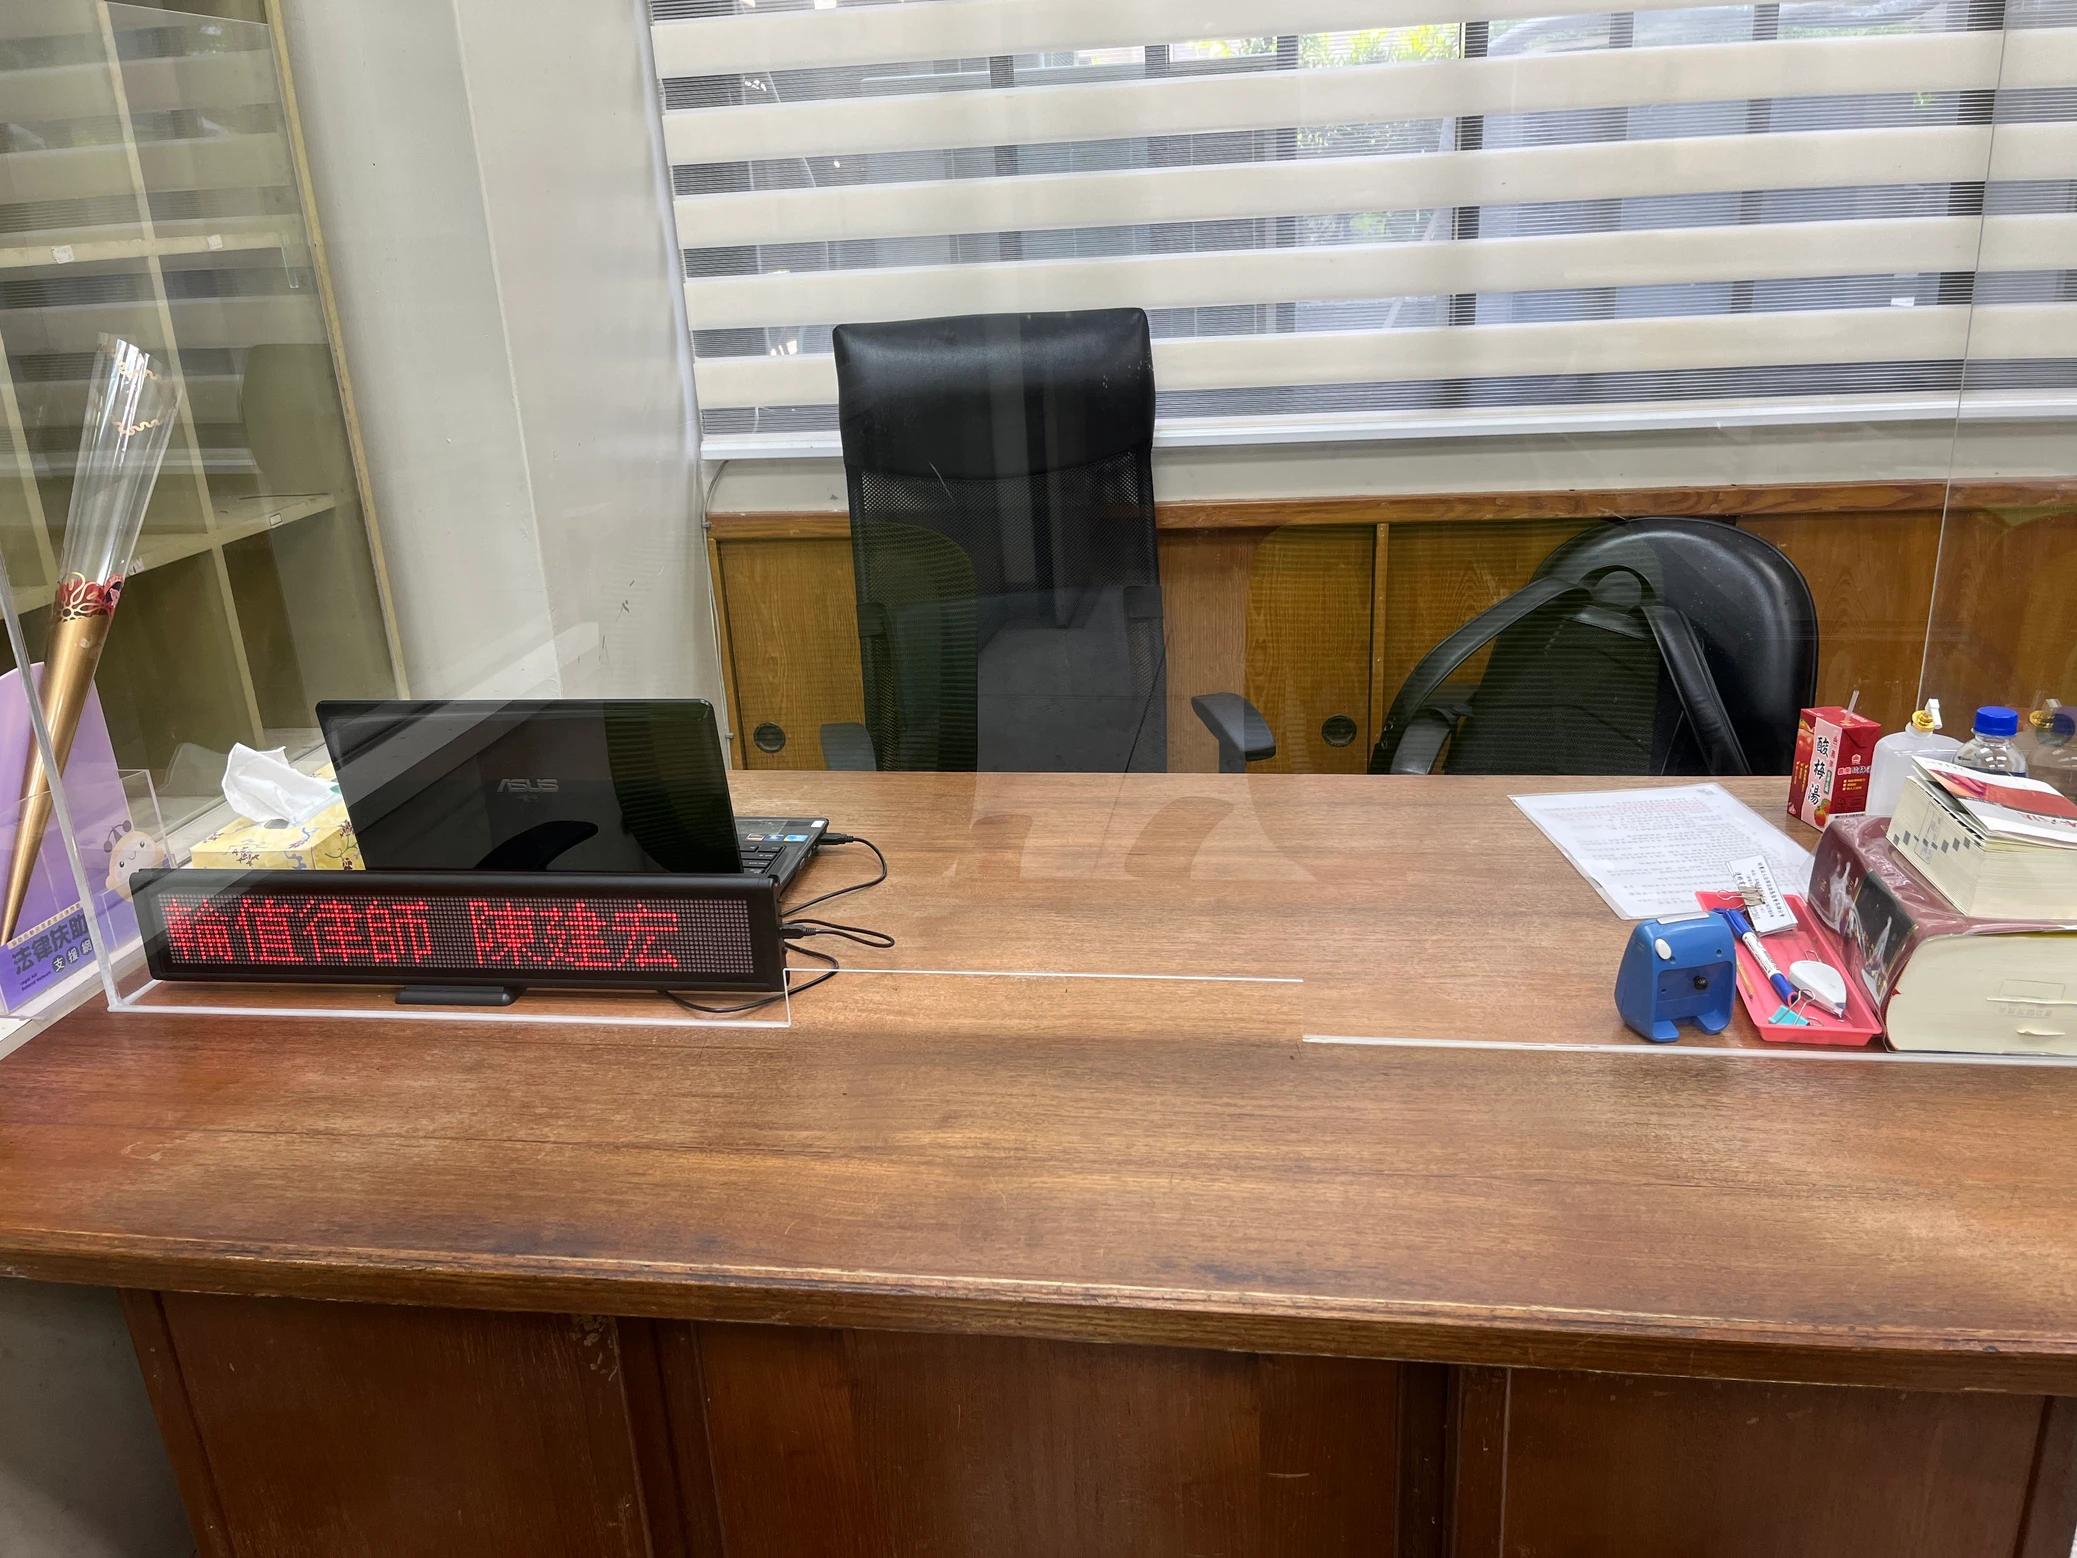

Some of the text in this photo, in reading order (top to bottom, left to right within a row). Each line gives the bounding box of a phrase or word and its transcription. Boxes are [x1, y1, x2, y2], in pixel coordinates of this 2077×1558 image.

[497, 778, 559, 793] ASUS
[1808, 737, 1830, 805] 酸梅湯
[12, 914, 90, 975] 法律扶助
[52, 938, 94, 973] 支援網
[166, 898, 680, 968] 輪值律師 陳建宏
